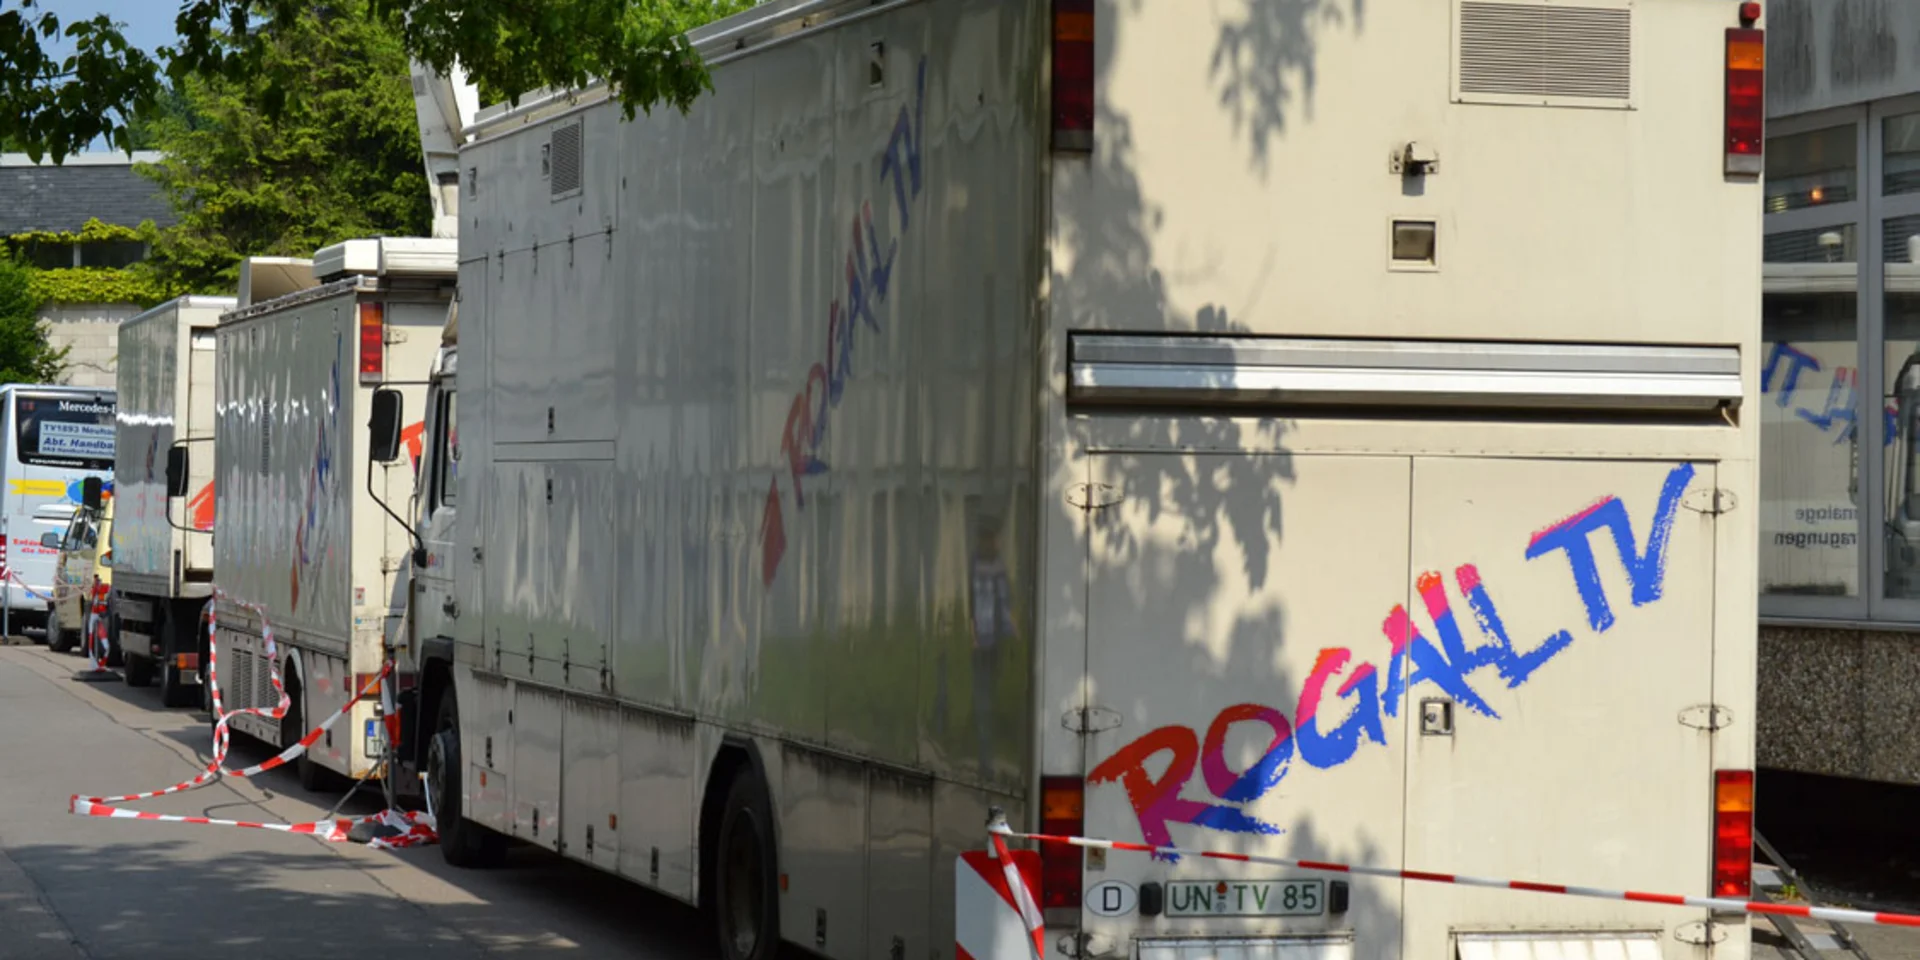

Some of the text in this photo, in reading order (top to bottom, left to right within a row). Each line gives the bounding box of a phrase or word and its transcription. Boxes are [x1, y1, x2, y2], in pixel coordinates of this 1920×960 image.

[880, 55, 927, 234] TV
[1087, 461, 1695, 864] ROGALL TV
[1103, 886, 1121, 911] D
[1172, 884, 1317, 911] UN TV 85
